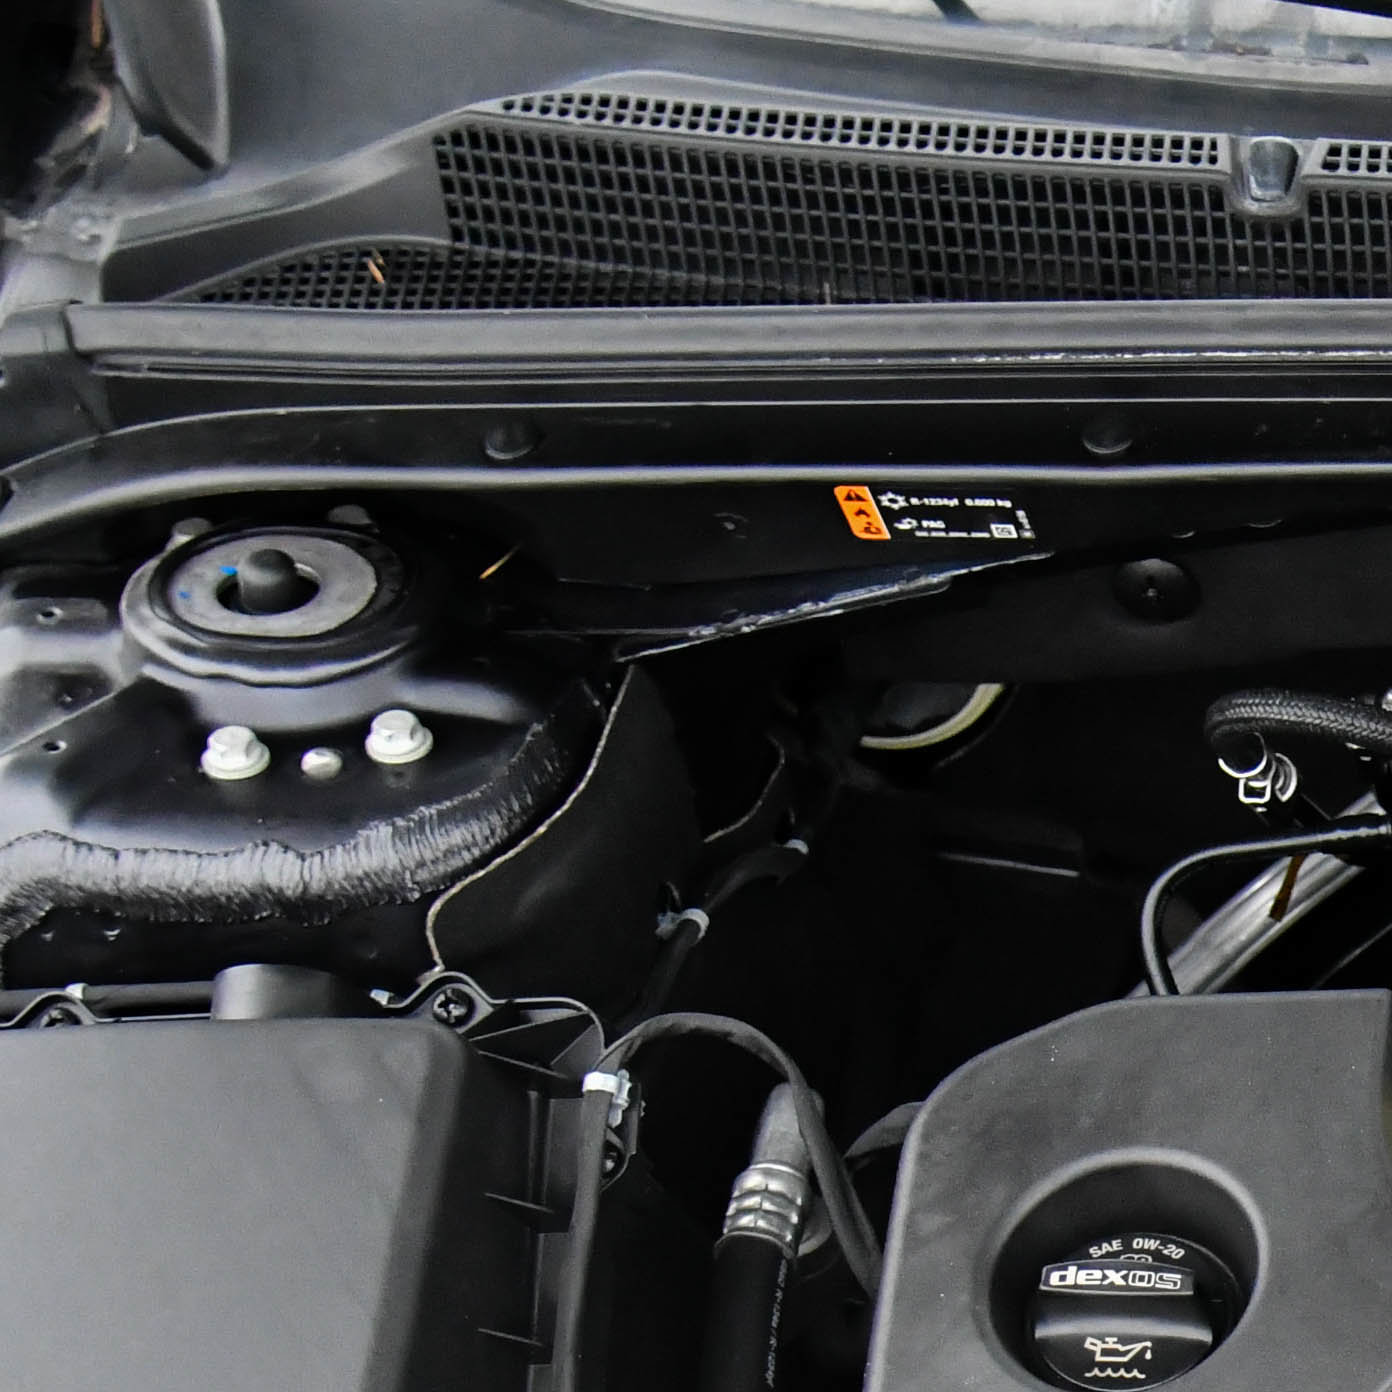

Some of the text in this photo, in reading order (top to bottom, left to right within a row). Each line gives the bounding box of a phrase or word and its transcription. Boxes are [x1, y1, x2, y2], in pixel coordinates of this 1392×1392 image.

[1089, 1238, 1185, 1260] SAE 0W-20
[1050, 1266, 1182, 1290] dexos
